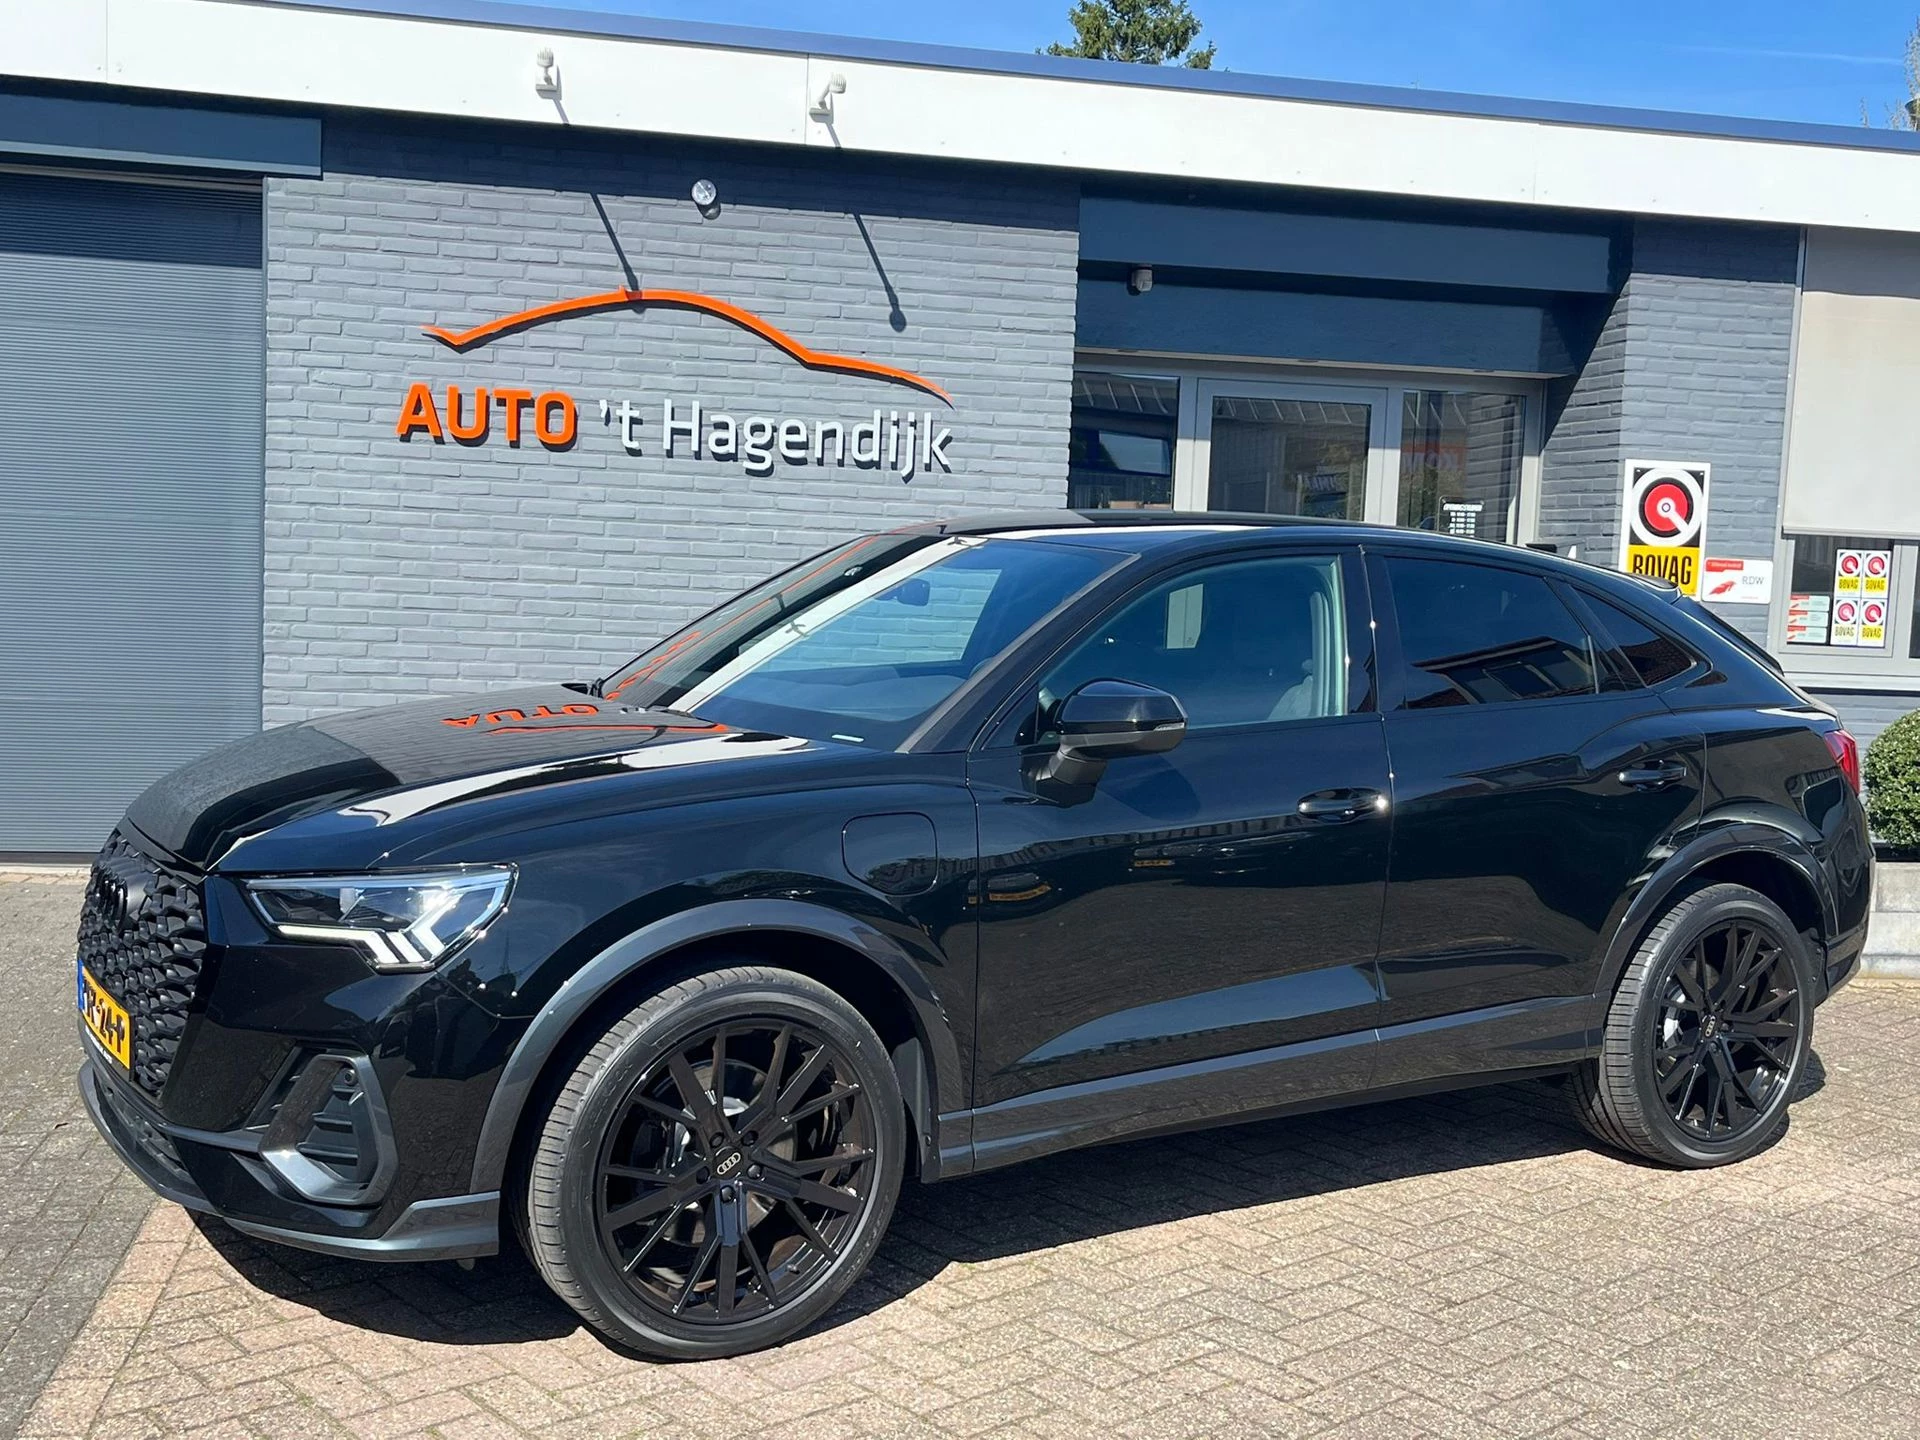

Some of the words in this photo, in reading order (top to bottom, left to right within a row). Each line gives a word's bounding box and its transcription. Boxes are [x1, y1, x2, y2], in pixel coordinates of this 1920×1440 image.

[395, 383, 576, 446] AUTO
[663, 399, 953, 478] Hagendijk
[1632, 553, 1692, 585] BOVAG
[1742, 576, 1765, 585] RDW
[1838, 578, 1859, 590] BOVAG
[1865, 579, 1885, 591] BOVAG
[1834, 626, 1855, 637] BOVAG
[1862, 627, 1882, 639] BOVAG
